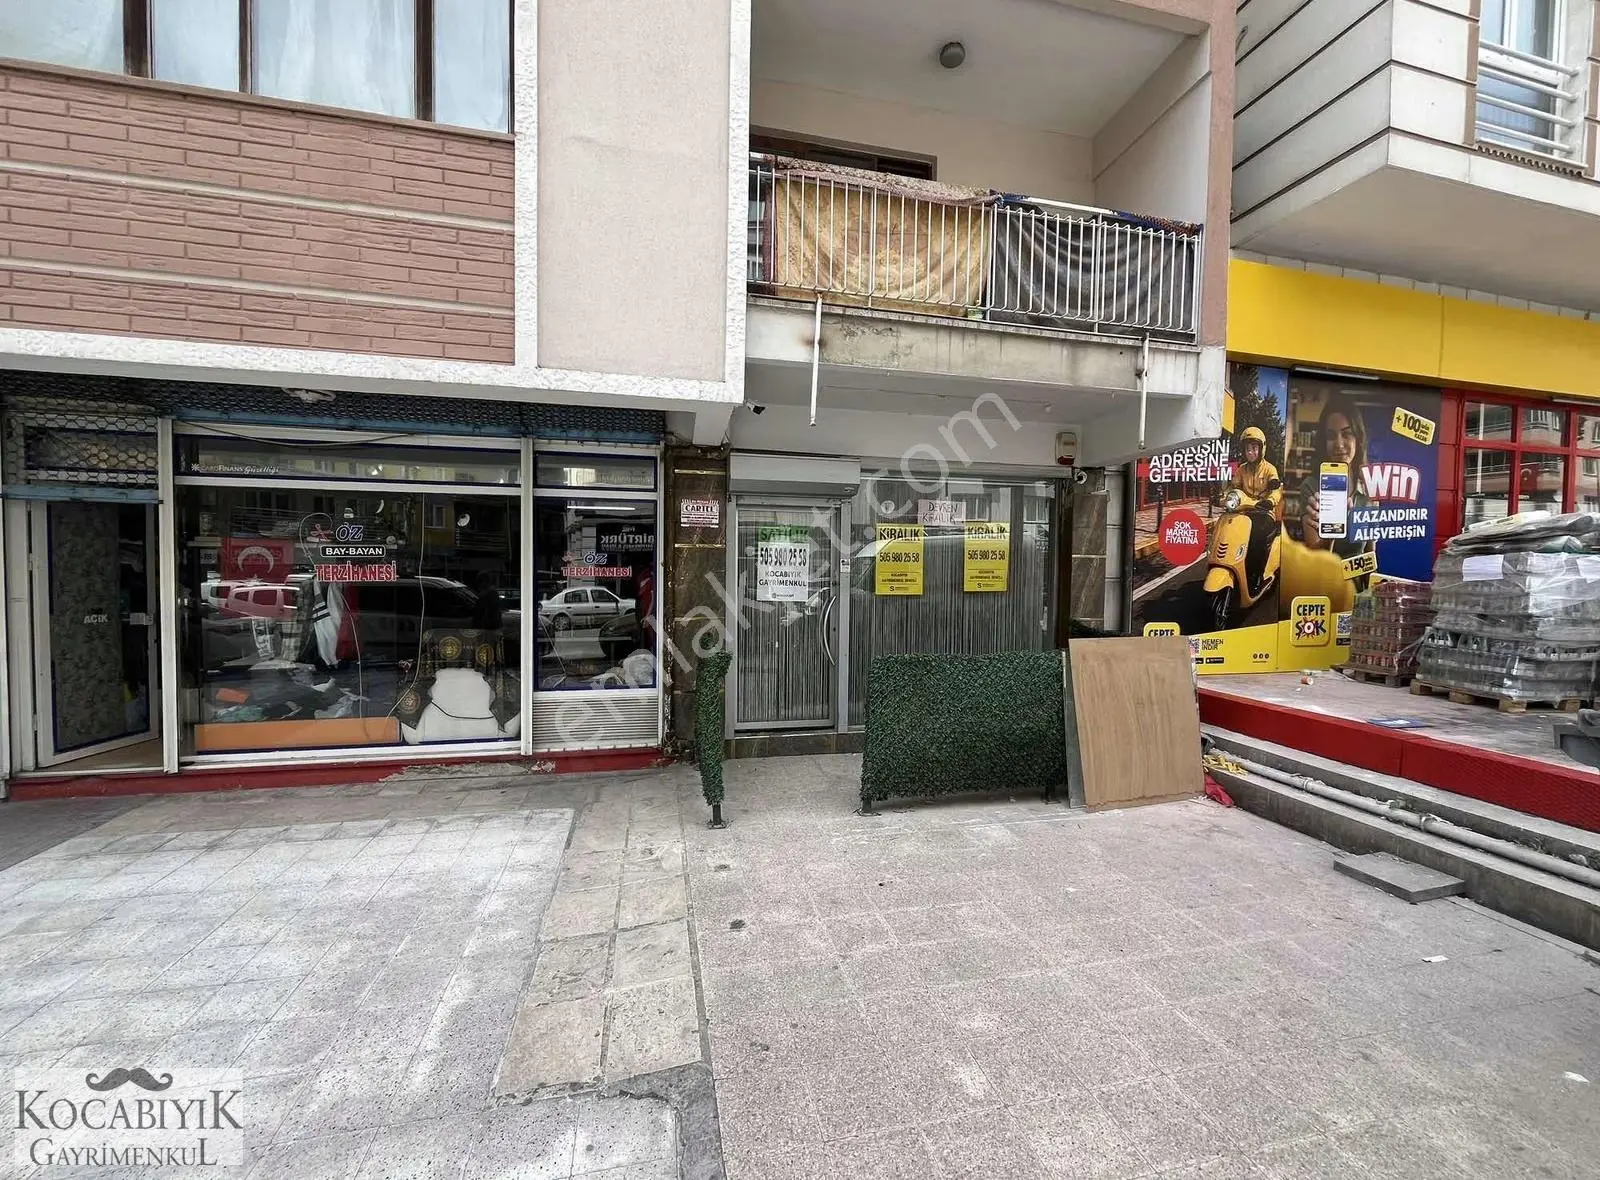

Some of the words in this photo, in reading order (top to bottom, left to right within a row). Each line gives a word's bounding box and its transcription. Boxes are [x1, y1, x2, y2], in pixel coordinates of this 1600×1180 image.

[1149, 466, 1232, 483] GETİRELİM
[1352, 508, 1428, 524] KAZANDIRIR
[335, 521, 364, 542] ÖZ
[1165, 528, 1199, 537] MARKET
[325, 547, 383, 556] BAY-BAYAN
[584, 551, 608, 565] ÖZ
[760, 547, 773, 566] 505
[314, 560, 397, 582] TERZİHANESİ
[1297, 604, 1325, 616] CEPTE
[1201, 638, 1224, 646] HEMEN
